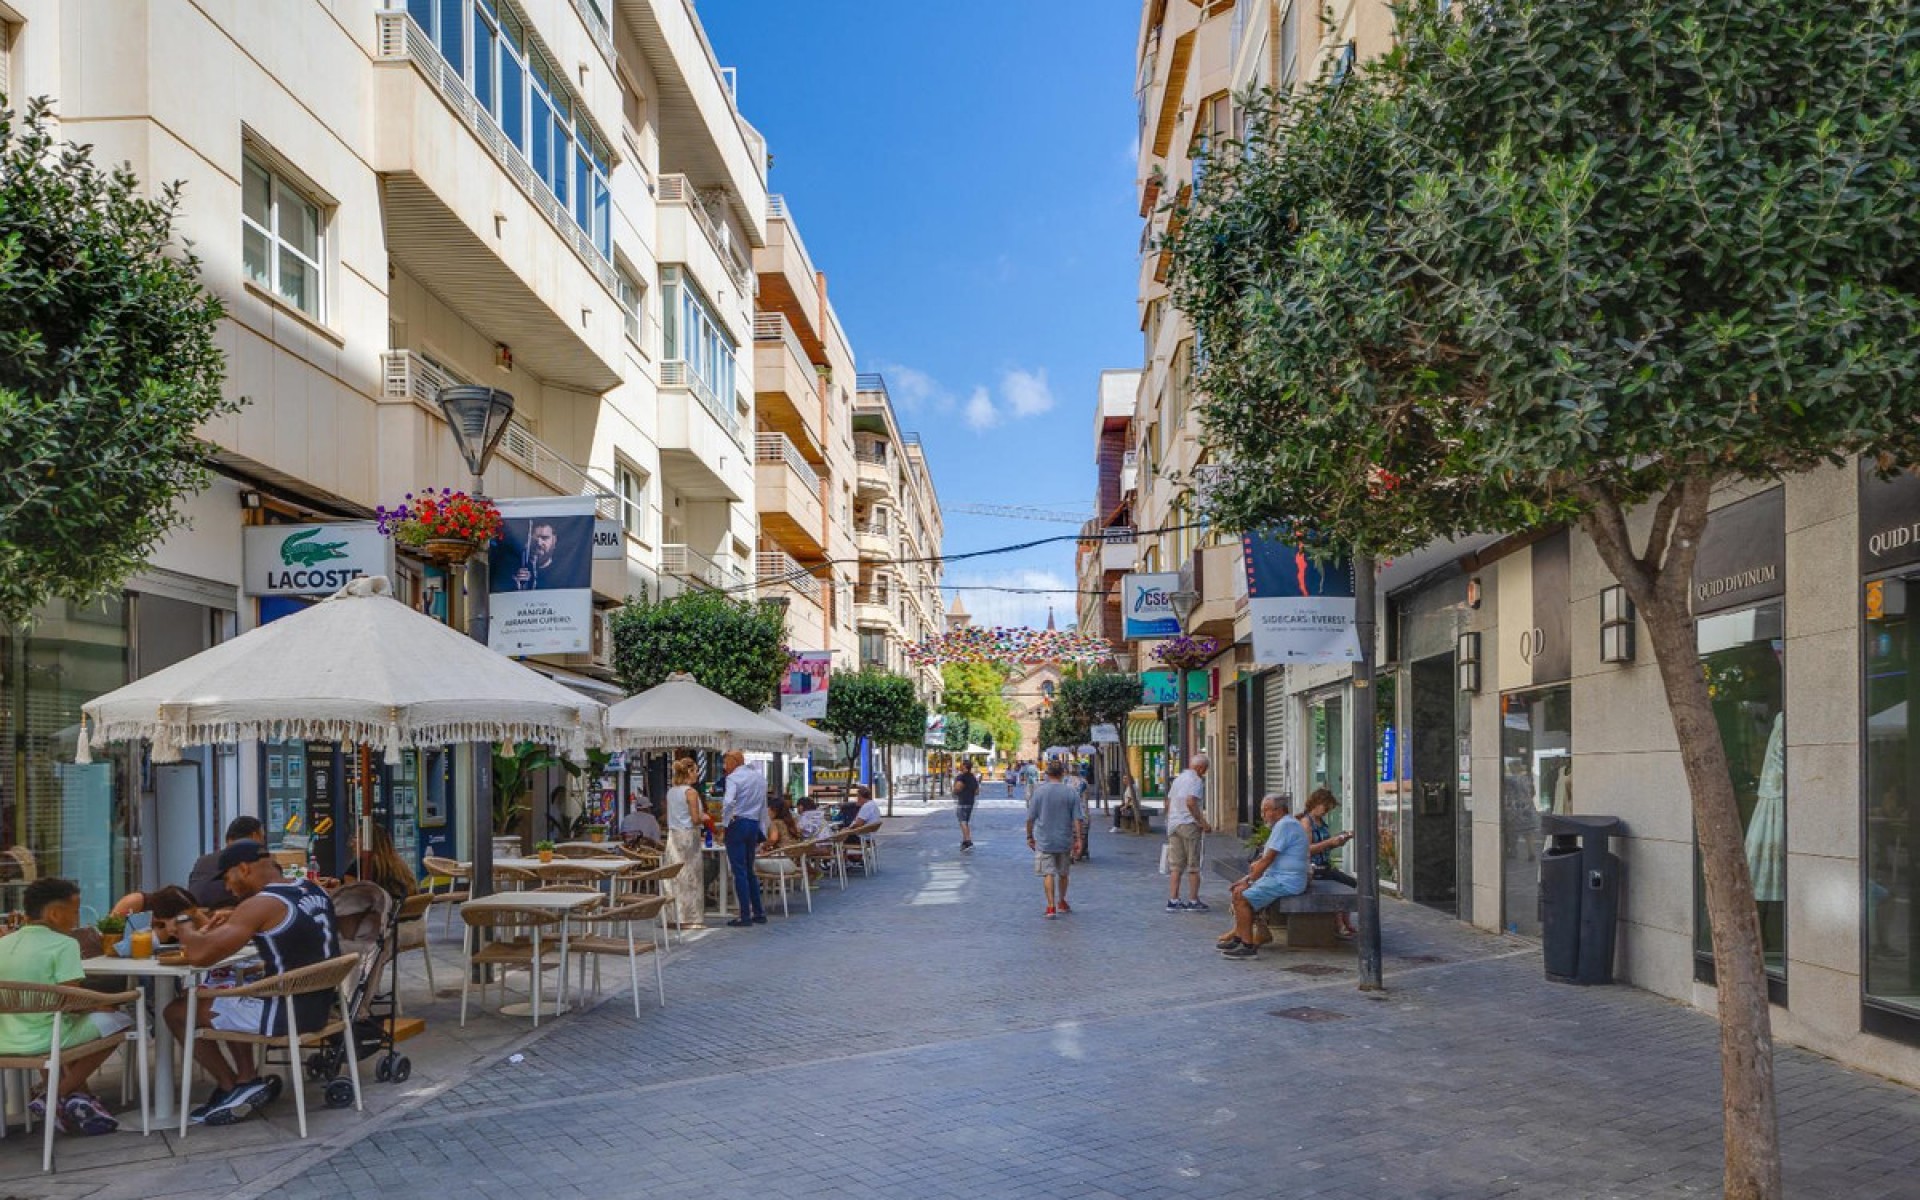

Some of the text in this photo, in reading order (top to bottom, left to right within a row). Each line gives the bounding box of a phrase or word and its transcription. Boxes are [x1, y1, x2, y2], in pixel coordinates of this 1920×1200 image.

[1869, 527, 1910, 557] QUID
[1697, 565, 1776, 601] QUID DIVINUM
[1312, 615, 1347, 625] EVEREST
